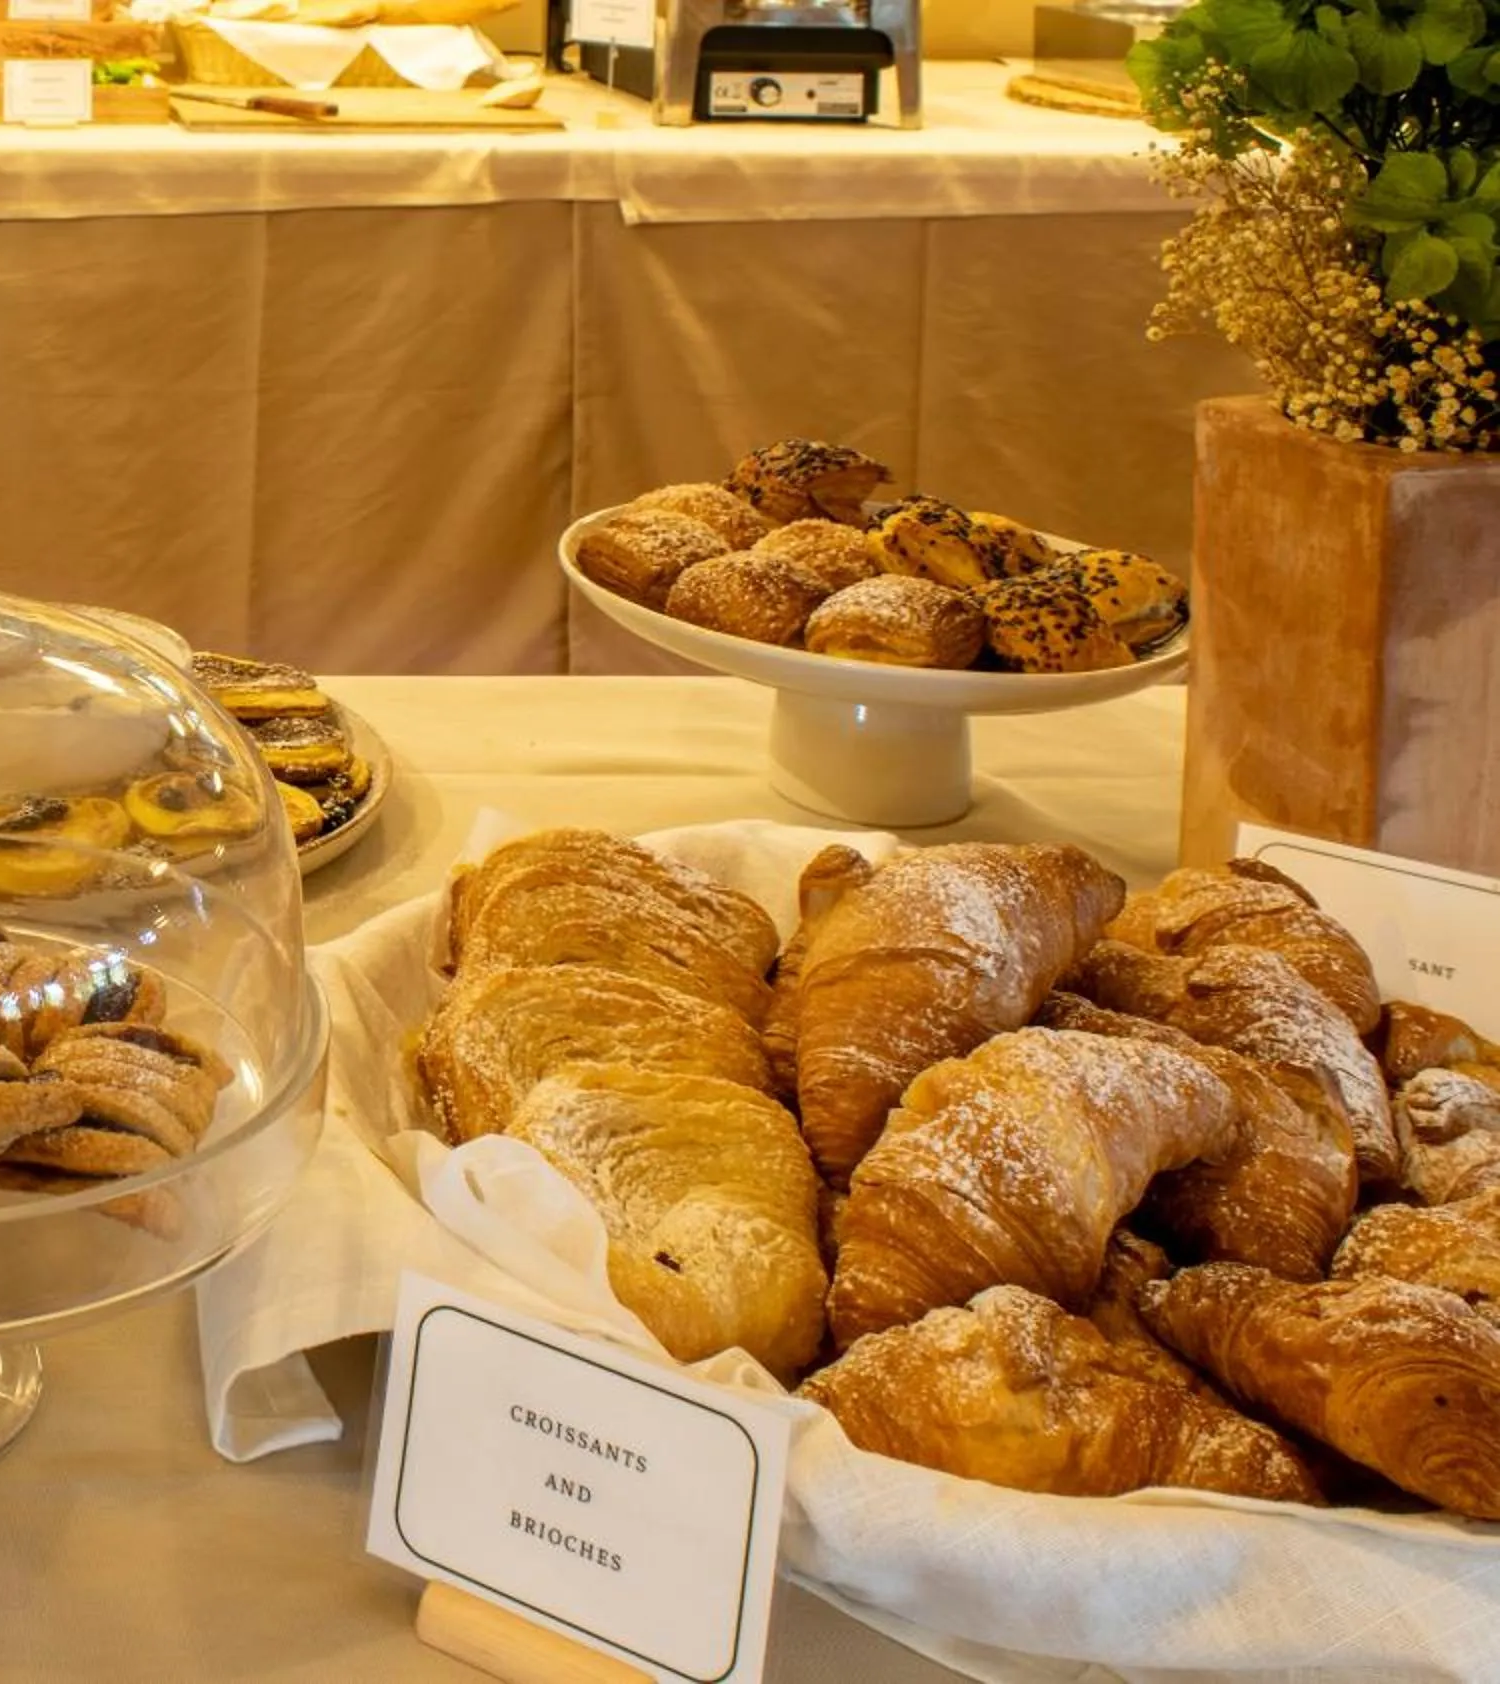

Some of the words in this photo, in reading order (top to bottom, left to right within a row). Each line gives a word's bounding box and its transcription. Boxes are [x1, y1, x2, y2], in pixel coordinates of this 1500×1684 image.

[510, 1404, 649, 1474] CROISSANTS
[544, 1473, 592, 1503] AND
[510, 1511, 624, 1572] BRIOCHES
